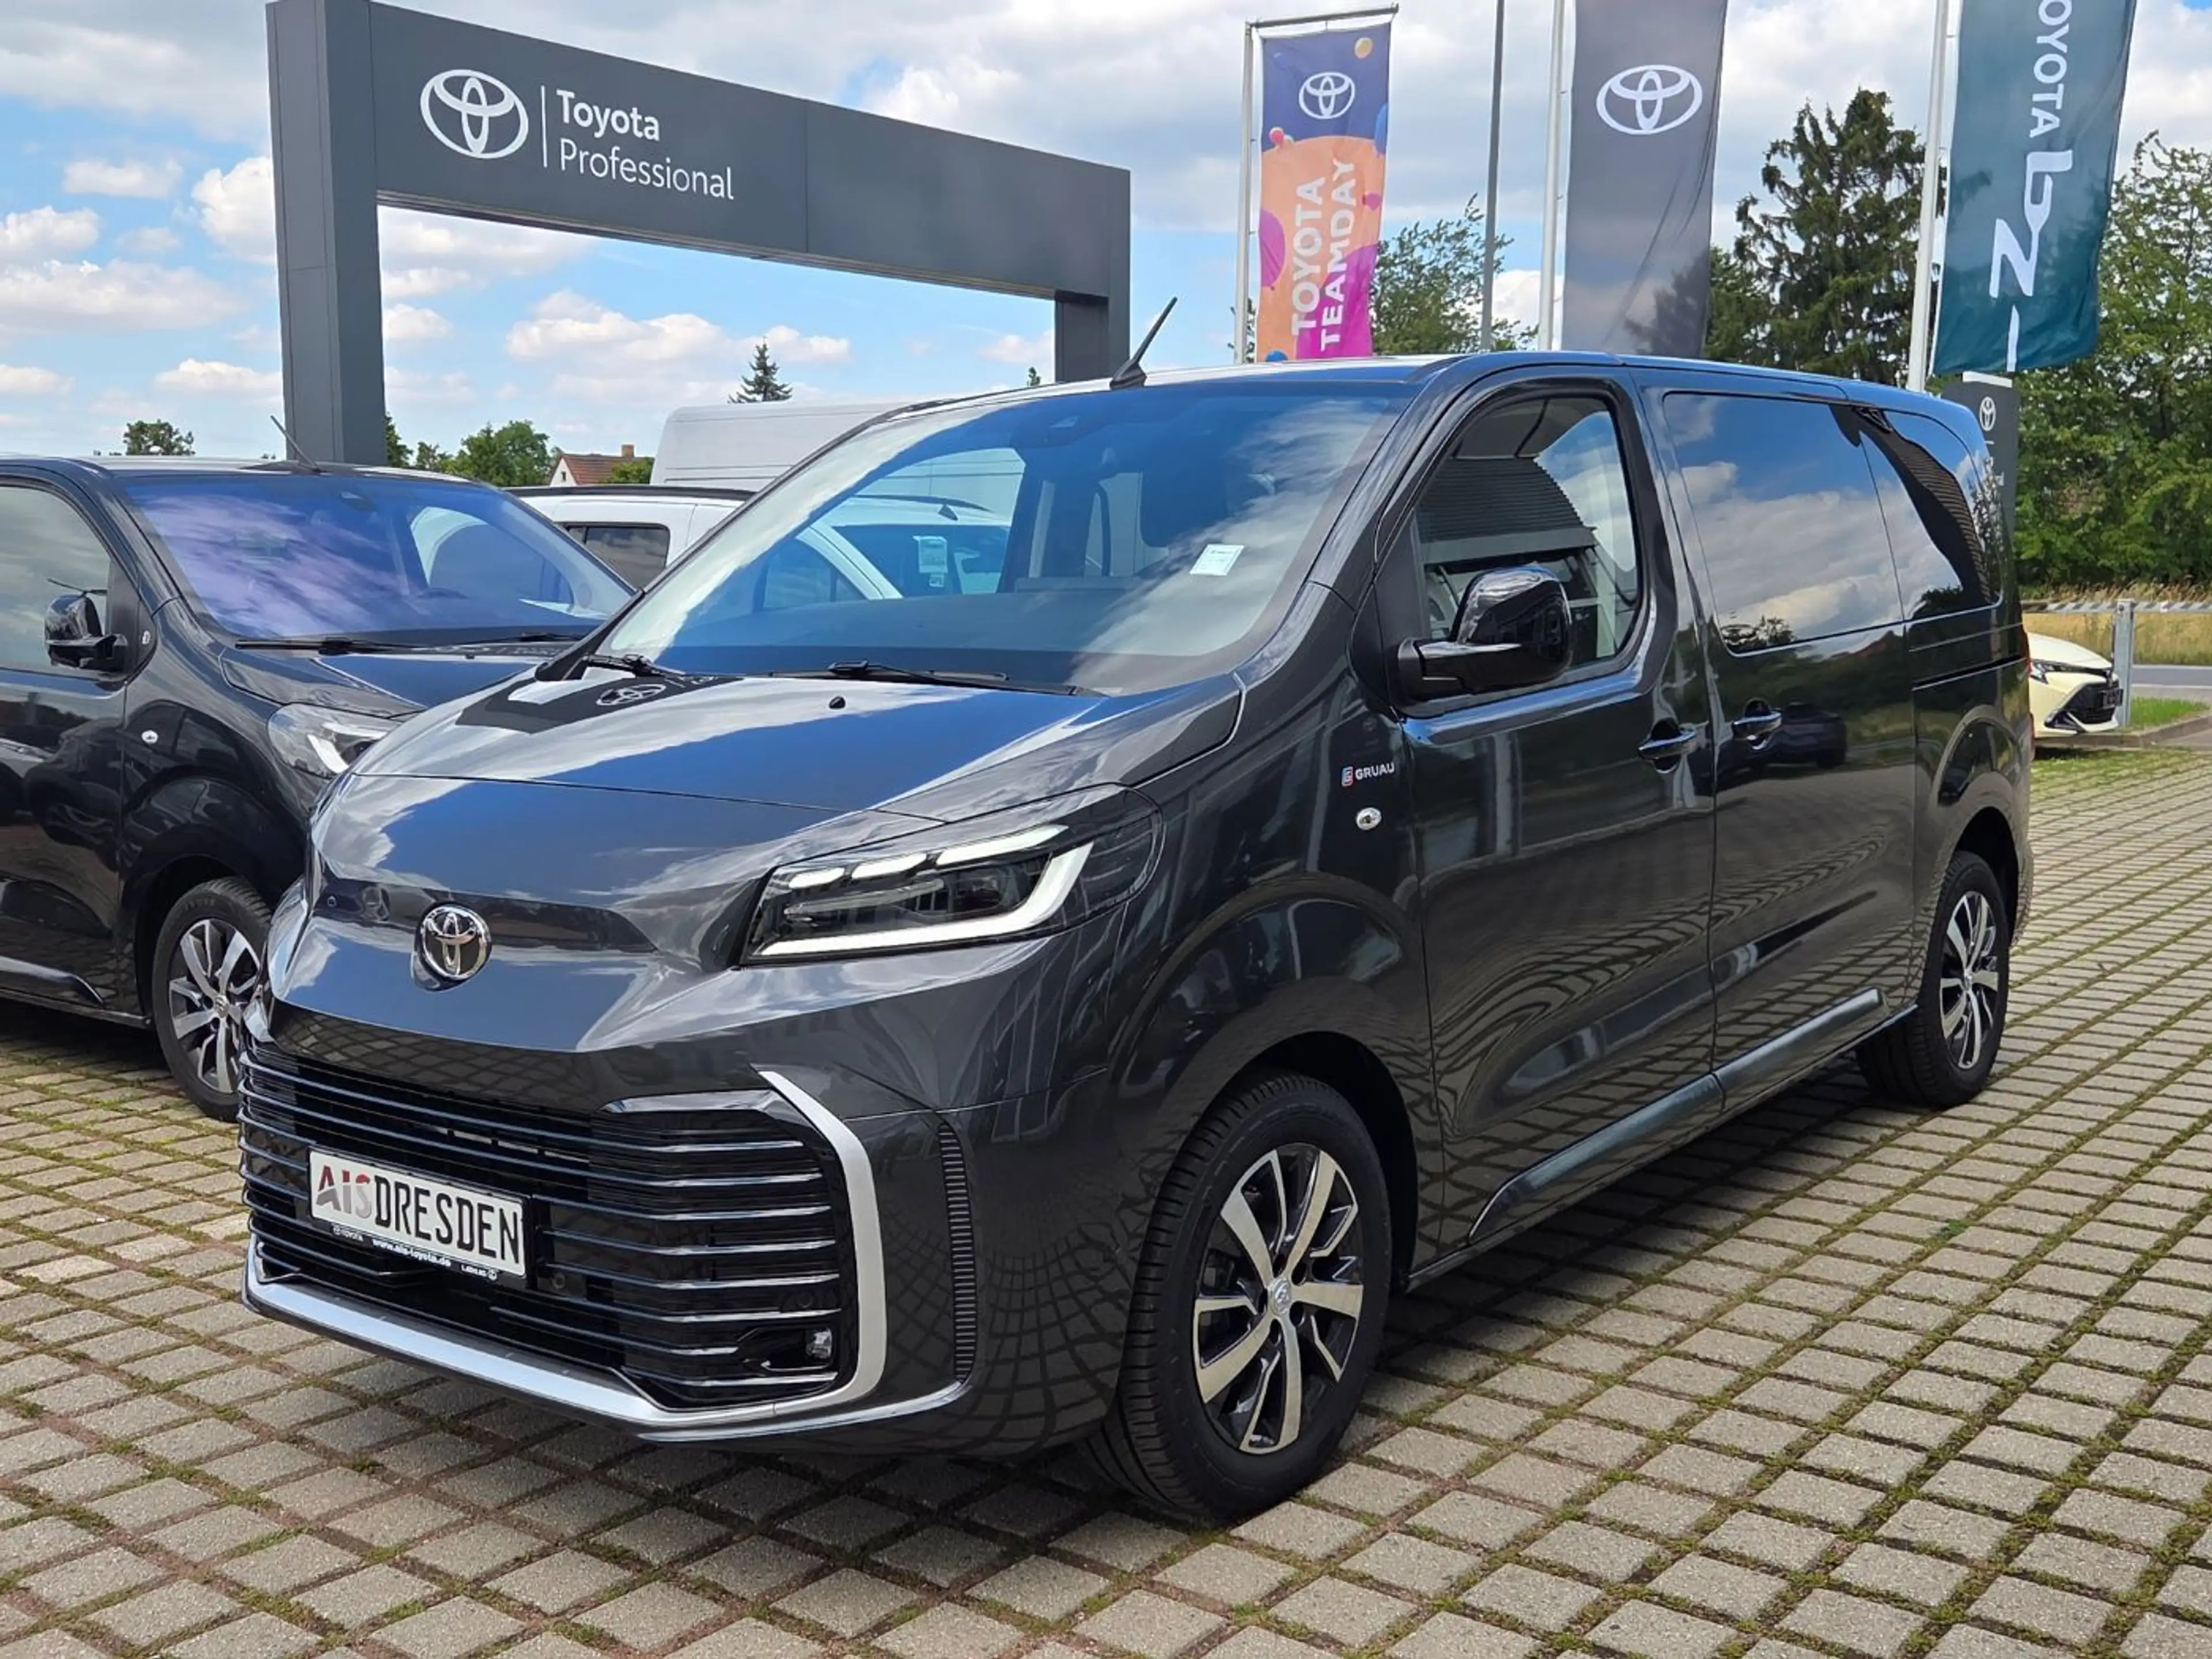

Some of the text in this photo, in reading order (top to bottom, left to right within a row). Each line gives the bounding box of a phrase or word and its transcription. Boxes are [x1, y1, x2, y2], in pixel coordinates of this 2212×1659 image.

[556, 89, 661, 142] Toyota
[2029, 0, 2073, 138] OYOTA
[559, 138, 734, 200] Professional
[1292, 177, 1324, 336] TOYOTA
[1320, 158, 1355, 351] TEAMDAY
[1355, 762, 1395, 780] GRUAU
